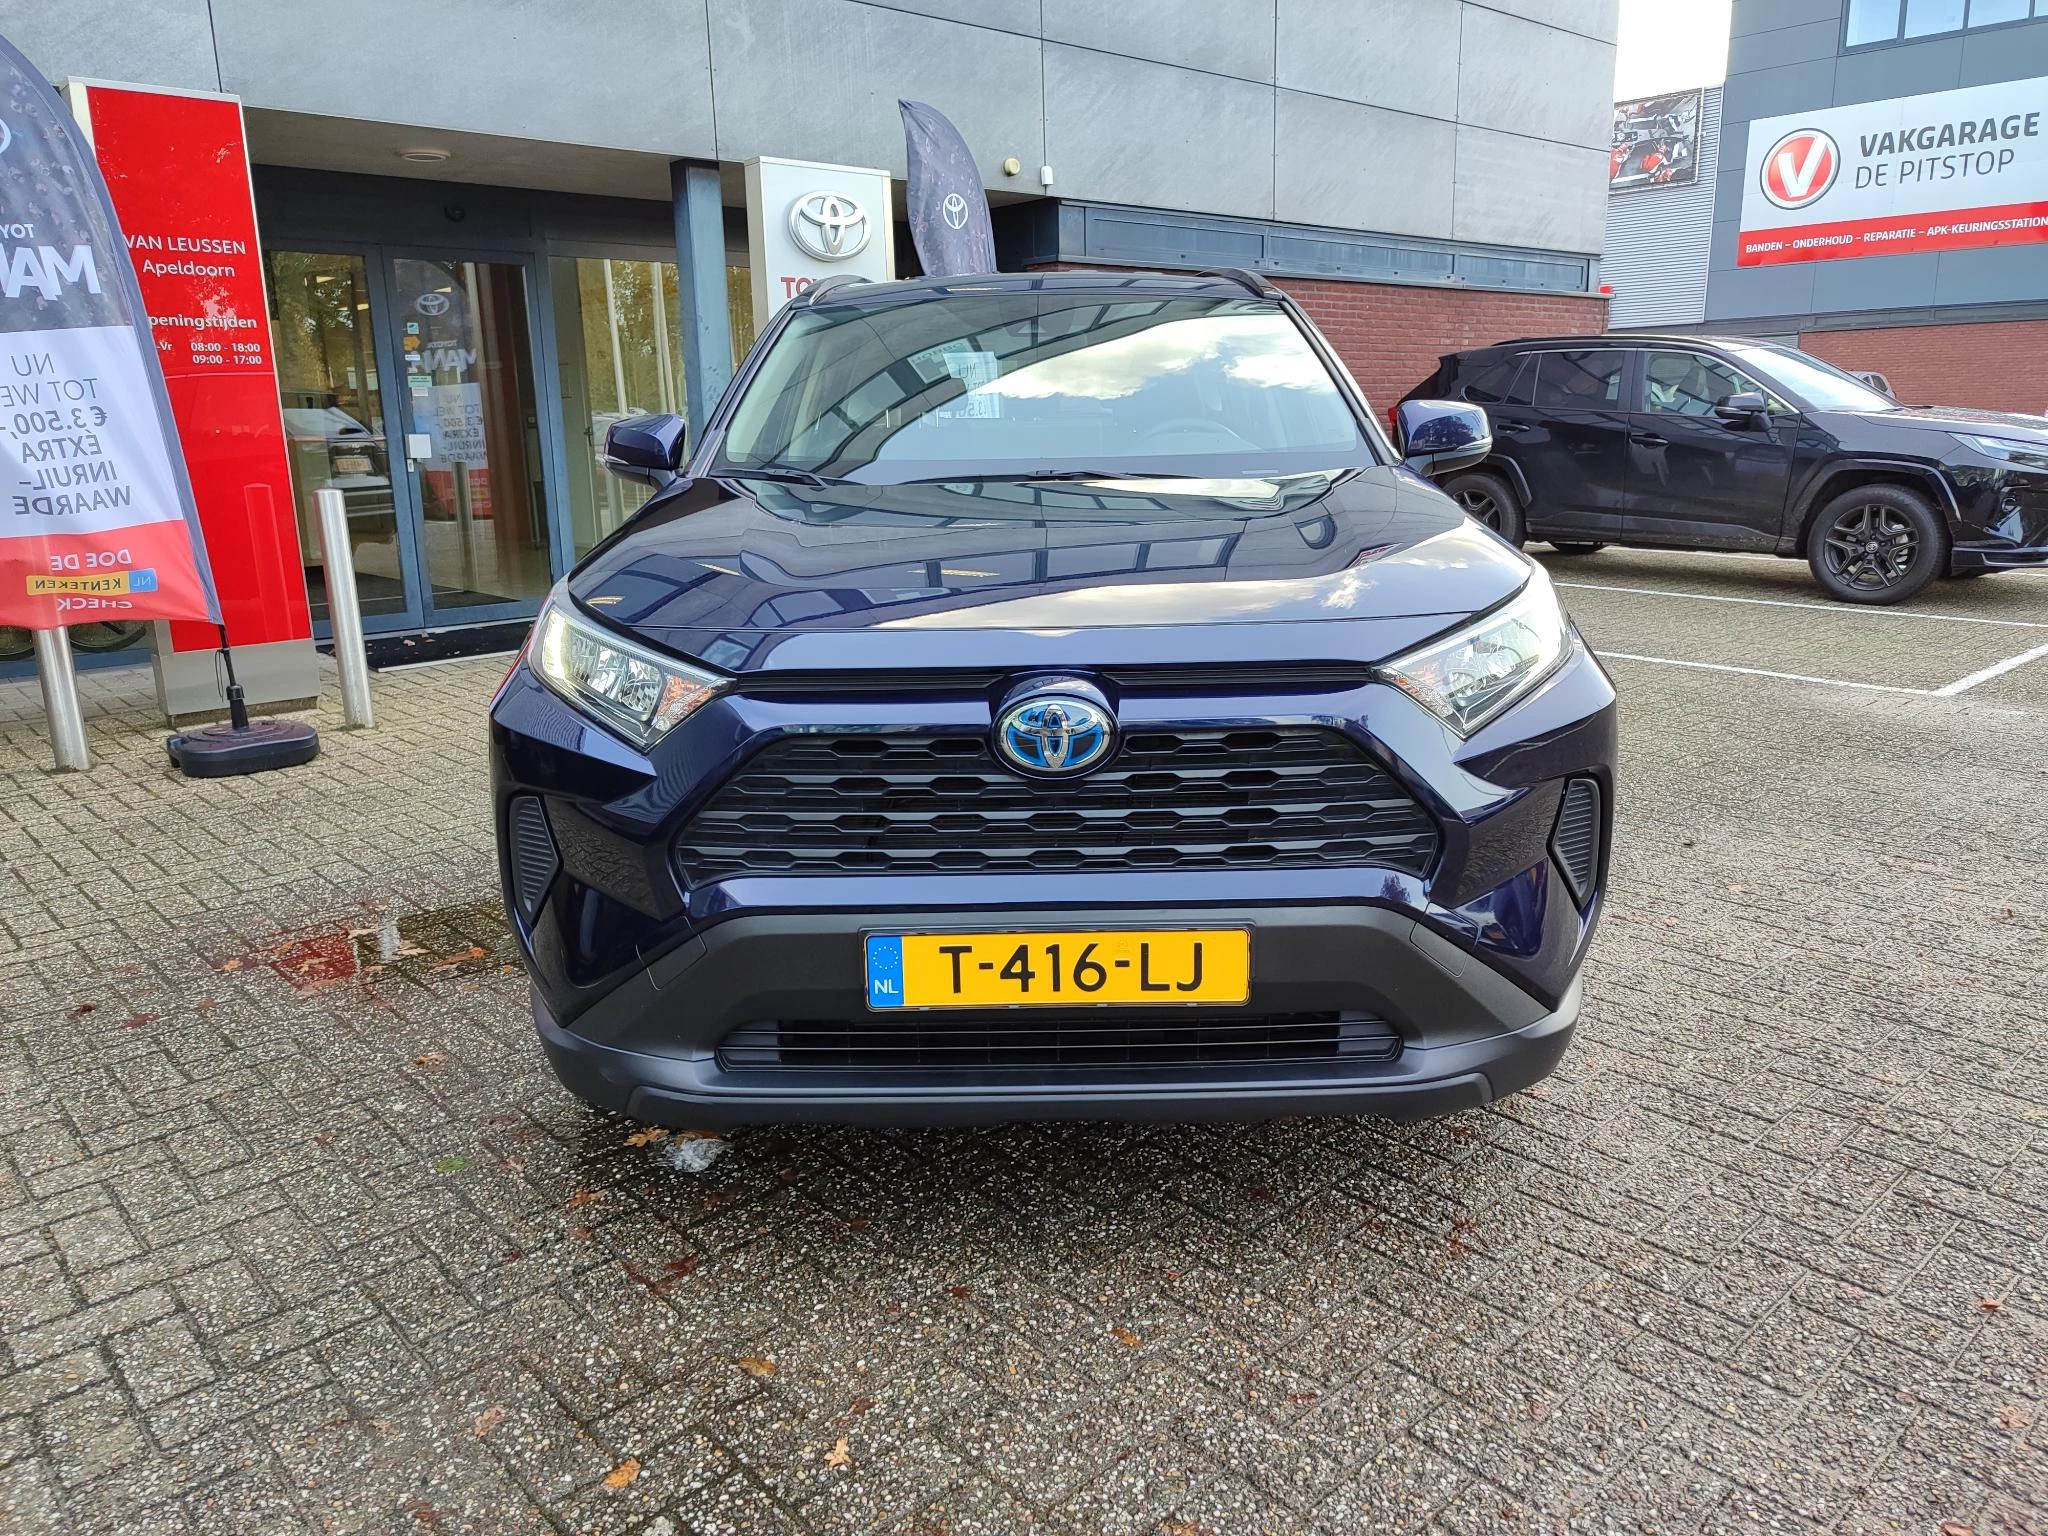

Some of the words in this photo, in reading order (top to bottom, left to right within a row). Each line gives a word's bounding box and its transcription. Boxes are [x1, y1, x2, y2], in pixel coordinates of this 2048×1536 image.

[1860, 112, 2040, 157] VAKGARAGE
[1855, 163, 1888, 189] DE
[1900, 149, 2014, 184] PITSTOP
[123, 234, 162, 250] VAN
[167, 236, 246, 255] LEUSSEN
[1746, 241, 1782, 253] BANDEN
[1793, 235, 1853, 249] ONDERHOUD
[1864, 228, 1916, 242] REPARATIE
[1927, 216, 2048, 236] APK-KEURINGSSTATION
[143, 259, 235, 277] Apeldoorn
[781, 277, 816, 298] TO
[147, 313, 257, 331] peningstijden
[191, 342, 221, 352] 08:00
[232, 343, 260, 352] 18:00
[193, 355, 223, 364] 09:00
[233, 355, 262, 364] 17:00
[874, 979, 898, 994] NL
[939, 942, 1203, 994] T-416-LJ
